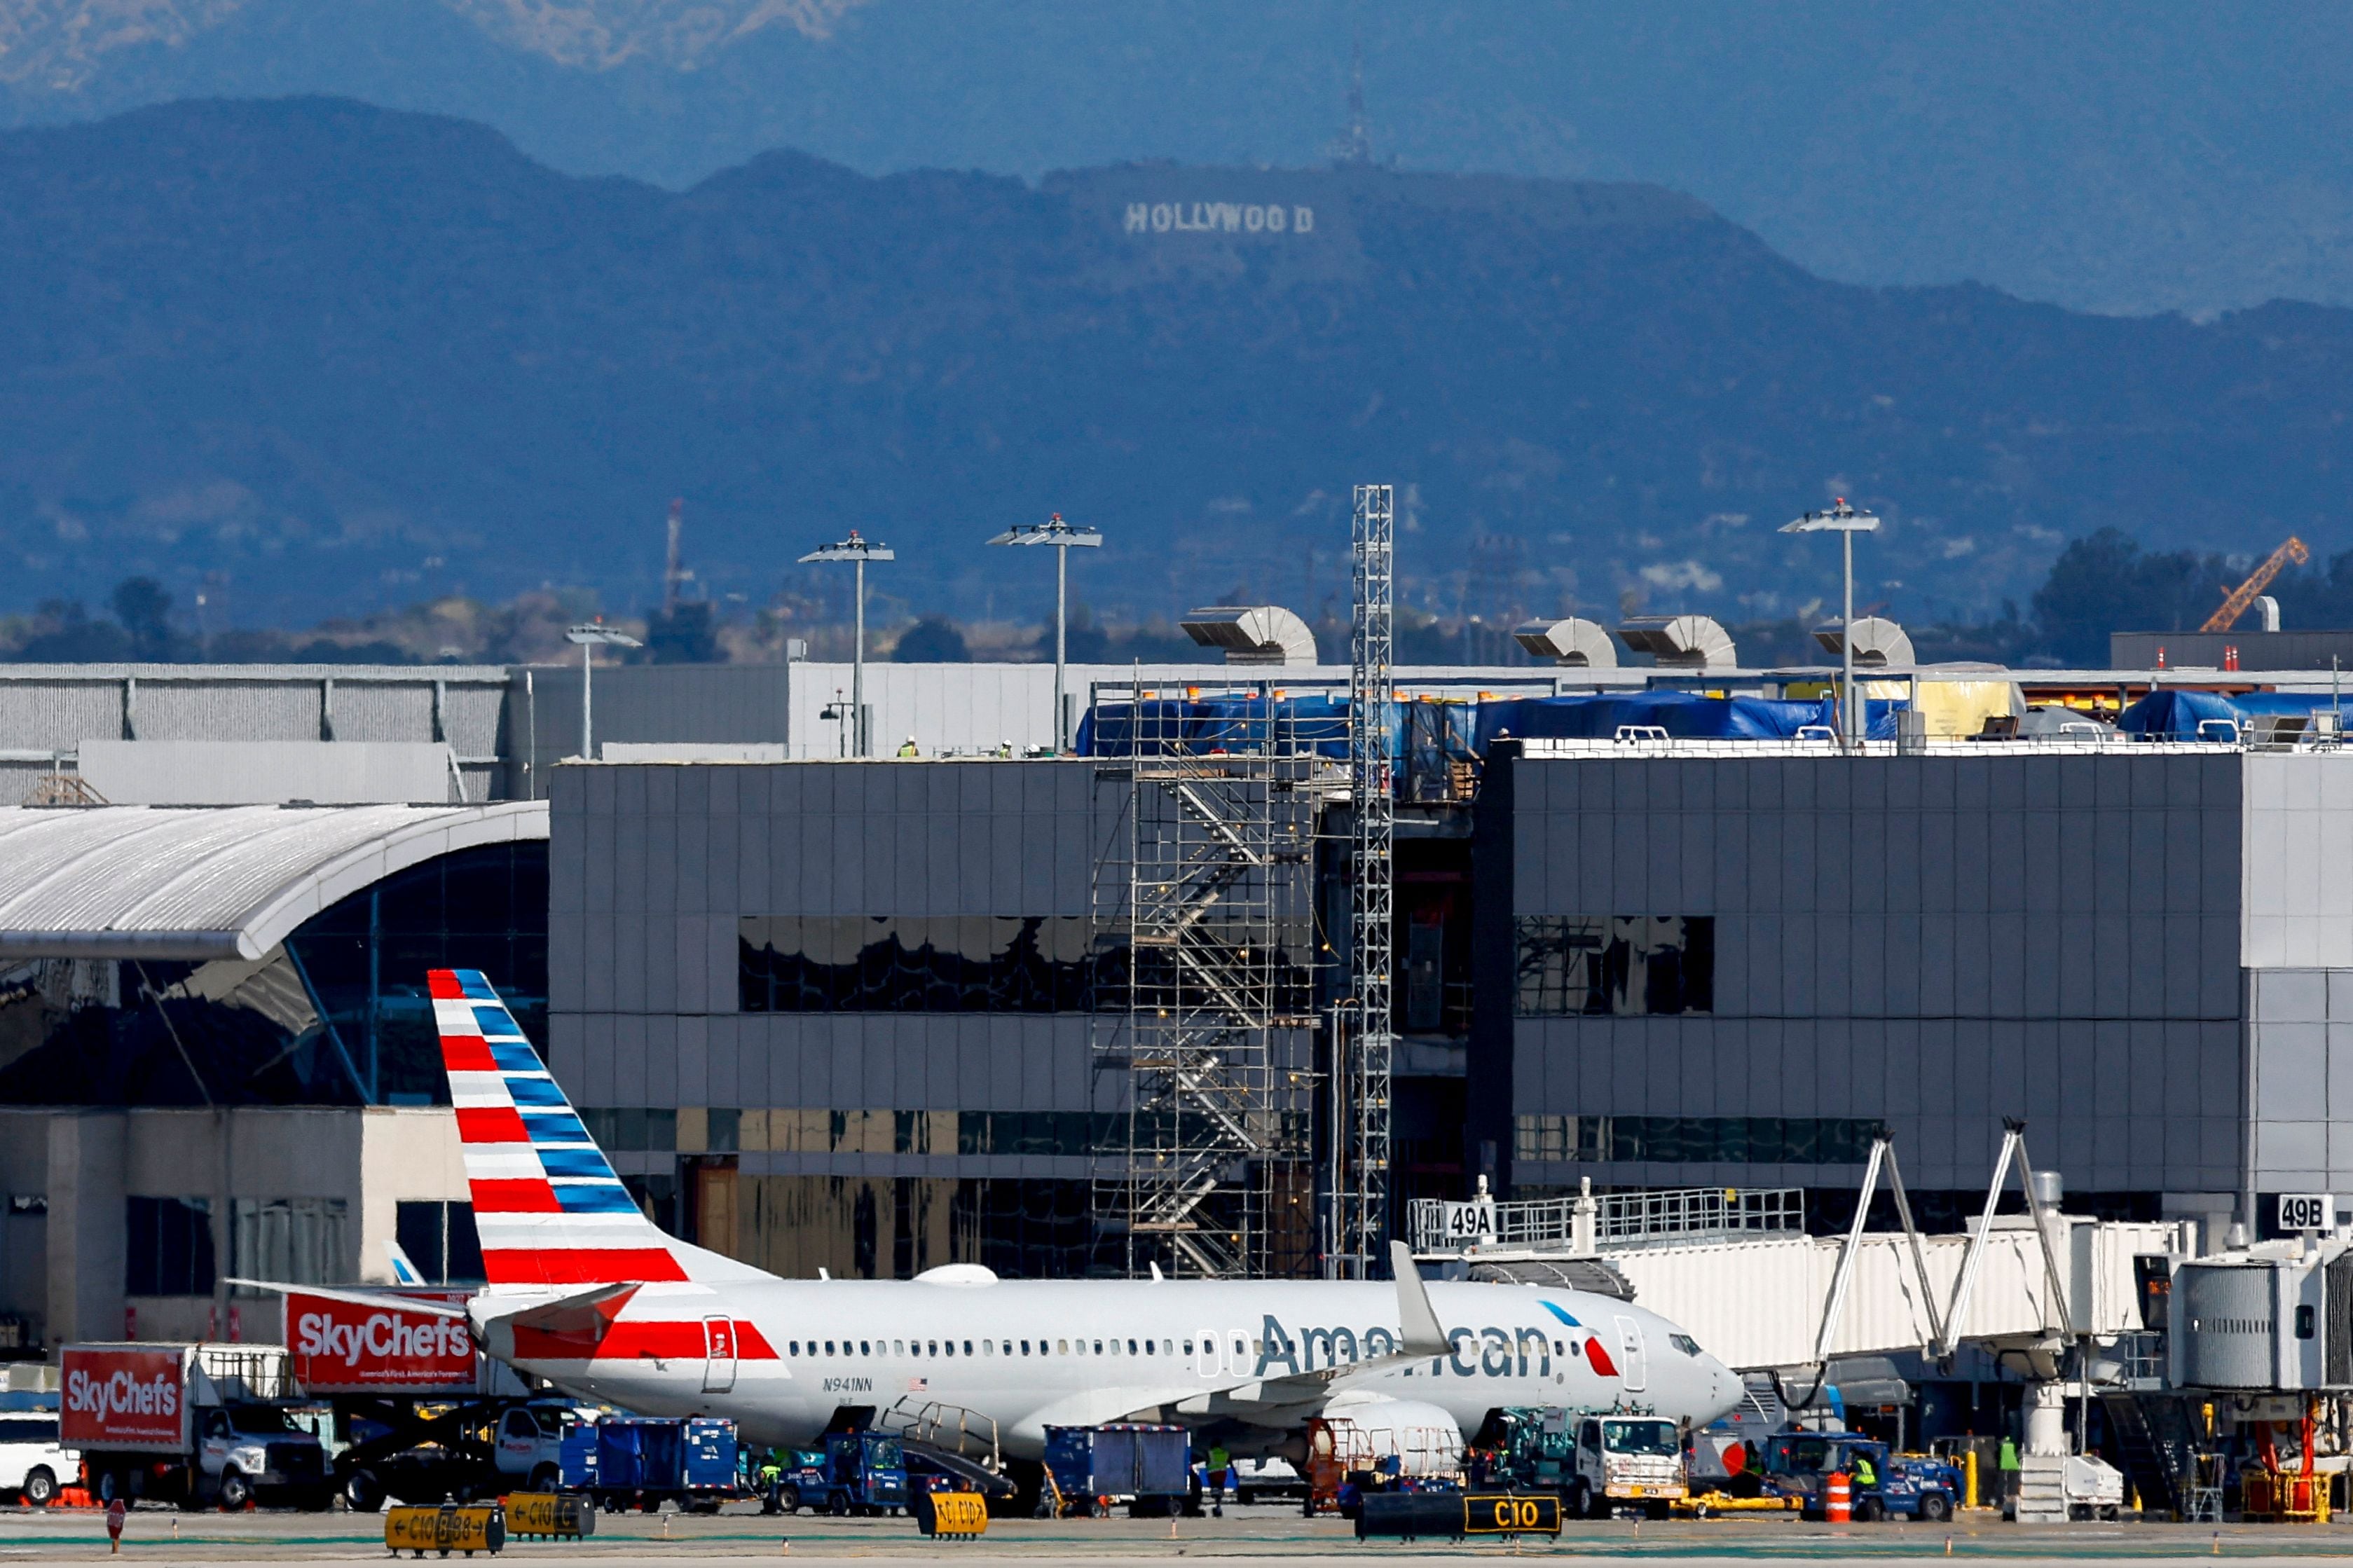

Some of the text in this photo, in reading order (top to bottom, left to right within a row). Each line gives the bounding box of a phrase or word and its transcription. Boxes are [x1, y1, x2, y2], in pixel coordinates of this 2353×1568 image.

[1125, 202, 1314, 233] HOLLYWOOD
[1451, 1206, 1491, 1235] 49A
[2282, 1199, 2322, 1227] 49B
[298, 1312, 469, 1366] SkyChefs
[1255, 1314, 1551, 1377] Amecan
[68, 1370, 177, 1423] SkyChefs
[823, 1377, 872, 1392] N941NN
[409, 1515, 434, 1541] C10
[530, 1501, 572, 1527] C10 C
[1494, 1501, 1539, 1527] C10
